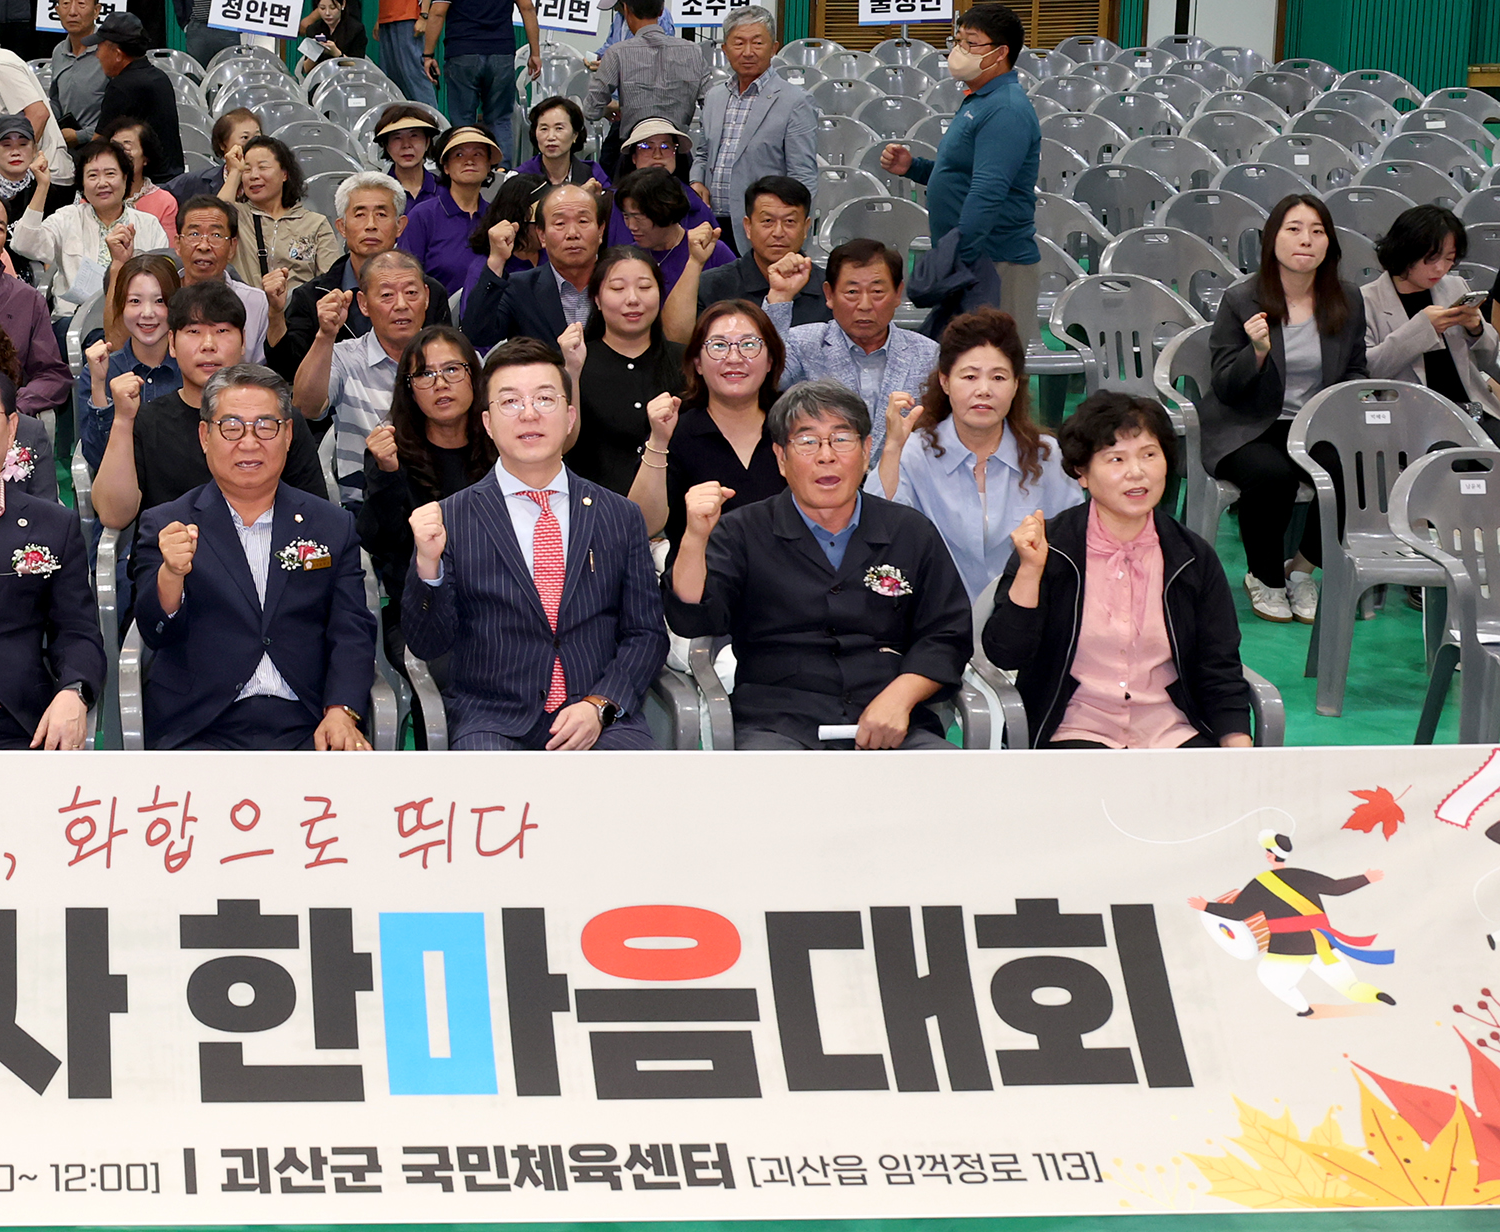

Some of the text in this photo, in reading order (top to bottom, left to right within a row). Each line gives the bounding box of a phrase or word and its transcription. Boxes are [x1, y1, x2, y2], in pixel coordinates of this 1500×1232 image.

[58, 785, 349, 873] 화합으로
[394, 797, 539, 869] 뛰다
[180, 898, 1194, 1103] 한마음대회
[50, 1162, 161, 1193] 12:00]
[221, 1147, 382, 1195] 괴산군
[402, 1143, 736, 1193] 국민체육센터
[747, 1155, 868, 1188] [괴산읍
[878, 1152, 1027, 1187] 임꺽정로
[1032, 1151, 1104, 1184] 113]
